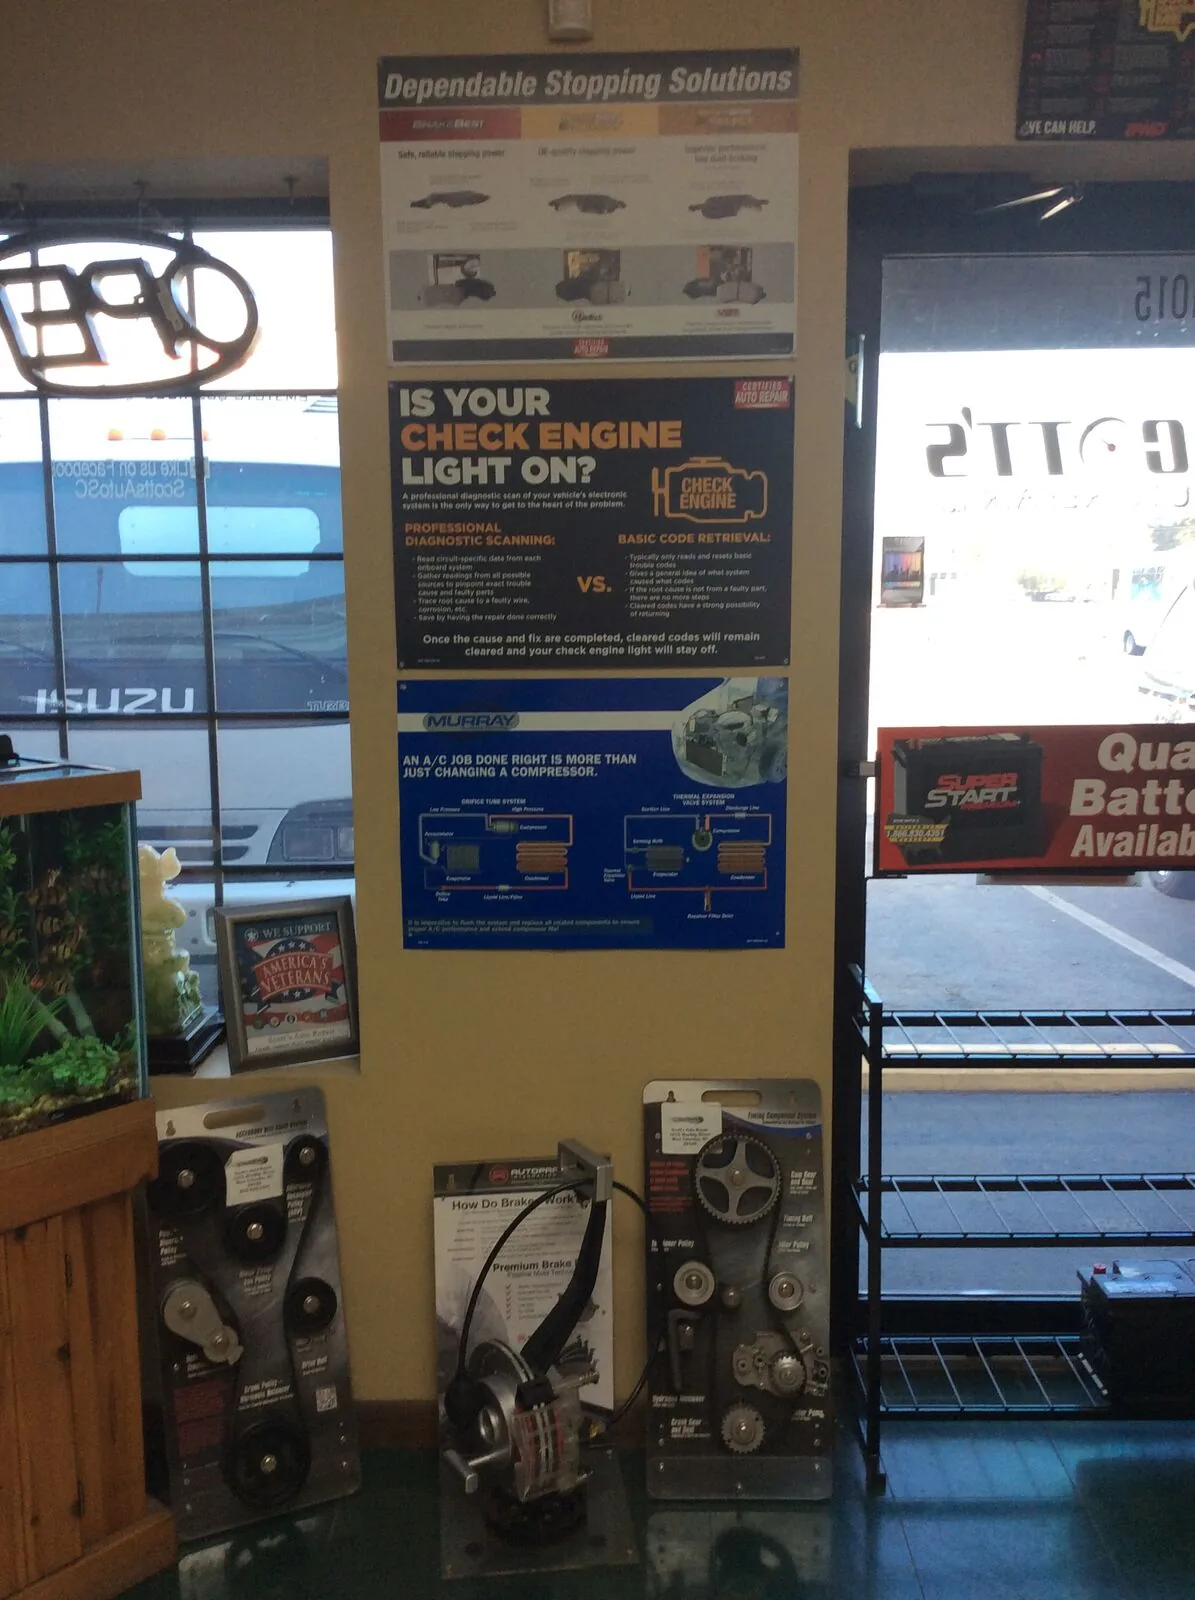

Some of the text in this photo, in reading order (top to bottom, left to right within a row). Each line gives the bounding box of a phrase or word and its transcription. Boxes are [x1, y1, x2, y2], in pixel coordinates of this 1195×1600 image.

[384, 67, 793, 104] Dependable Stopping Solutions
[1044, 120, 1067, 134] CAN
[1069, 119, 1097, 134] HELP.
[742, 381, 783, 391] CERTIFIED
[400, 387, 550, 417] IS YOUR
[735, 390, 788, 403] AUTO REPAIR
[401, 420, 682, 452] CHECK ENGINE
[402, 455, 597, 486] LIGHT ON?
[681, 477, 733, 493] CHECK
[402, 492, 409, 500] A
[410, 492, 458, 502] professional
[459, 492, 501, 501] diagnostic
[522, 491, 531, 499] of
[532, 493, 551, 501] your
[552, 491, 586, 499] vehicle's
[587, 491, 627, 499] electronic
[679, 493, 736, 509] ENGINE
[402, 502, 430, 511] system
[454, 501, 472, 510] only
[501, 501, 515, 510] get
[589, 501, 625, 509] problem.
[405, 523, 502, 534] PROFESSIONAL
[405, 535, 556, 547] DIAGNOSTIC SCANNING:
[618, 532, 771, 544] BASIC CODE RETRIEVAL:
[576, 576, 612, 593] VS.
[436, 615, 445, 624] by
[446, 614, 470, 624] having
[471, 614, 483, 622] the
[484, 614, 505, 623] repair
[506, 614, 524, 622] done
[525, 613, 557, 623] correctly
[423, 635, 450, 644] Once
[452, 635, 470, 644] the
[505, 634, 526, 643] and
[527, 634, 542, 643] fix
[563, 633, 623, 644] completed,
[625, 633, 665, 642] cleared
[667, 633, 700, 642] codes
[702, 632, 720, 641] will
[722, 632, 760, 641] remain
[465, 644, 718, 657] cleared and your check engine light will stay off.
[36, 688, 194, 713] ISUZU
[427, 714, 516, 728] MURRAY
[403, 753, 637, 765] AN A/C JOB DONE RIGHT IS MORE THAN
[1097, 732, 1195, 774] Qua
[403, 767, 598, 777] JUST CHANGING A COMPRESSOR.
[937, 772, 1018, 790] SUPER
[924, 787, 1018, 808] START
[262, 921, 332, 938] WE SUPPORT
[262, 955, 328, 978] AMERICA'S
[260, 971, 329, 993] VETERANS
[452, 1199, 478, 1210] How
[481, 1198, 498, 1209] Do
[501, 1196, 535, 1207] Brake
[492, 1259, 572, 1273] Premium Brake
